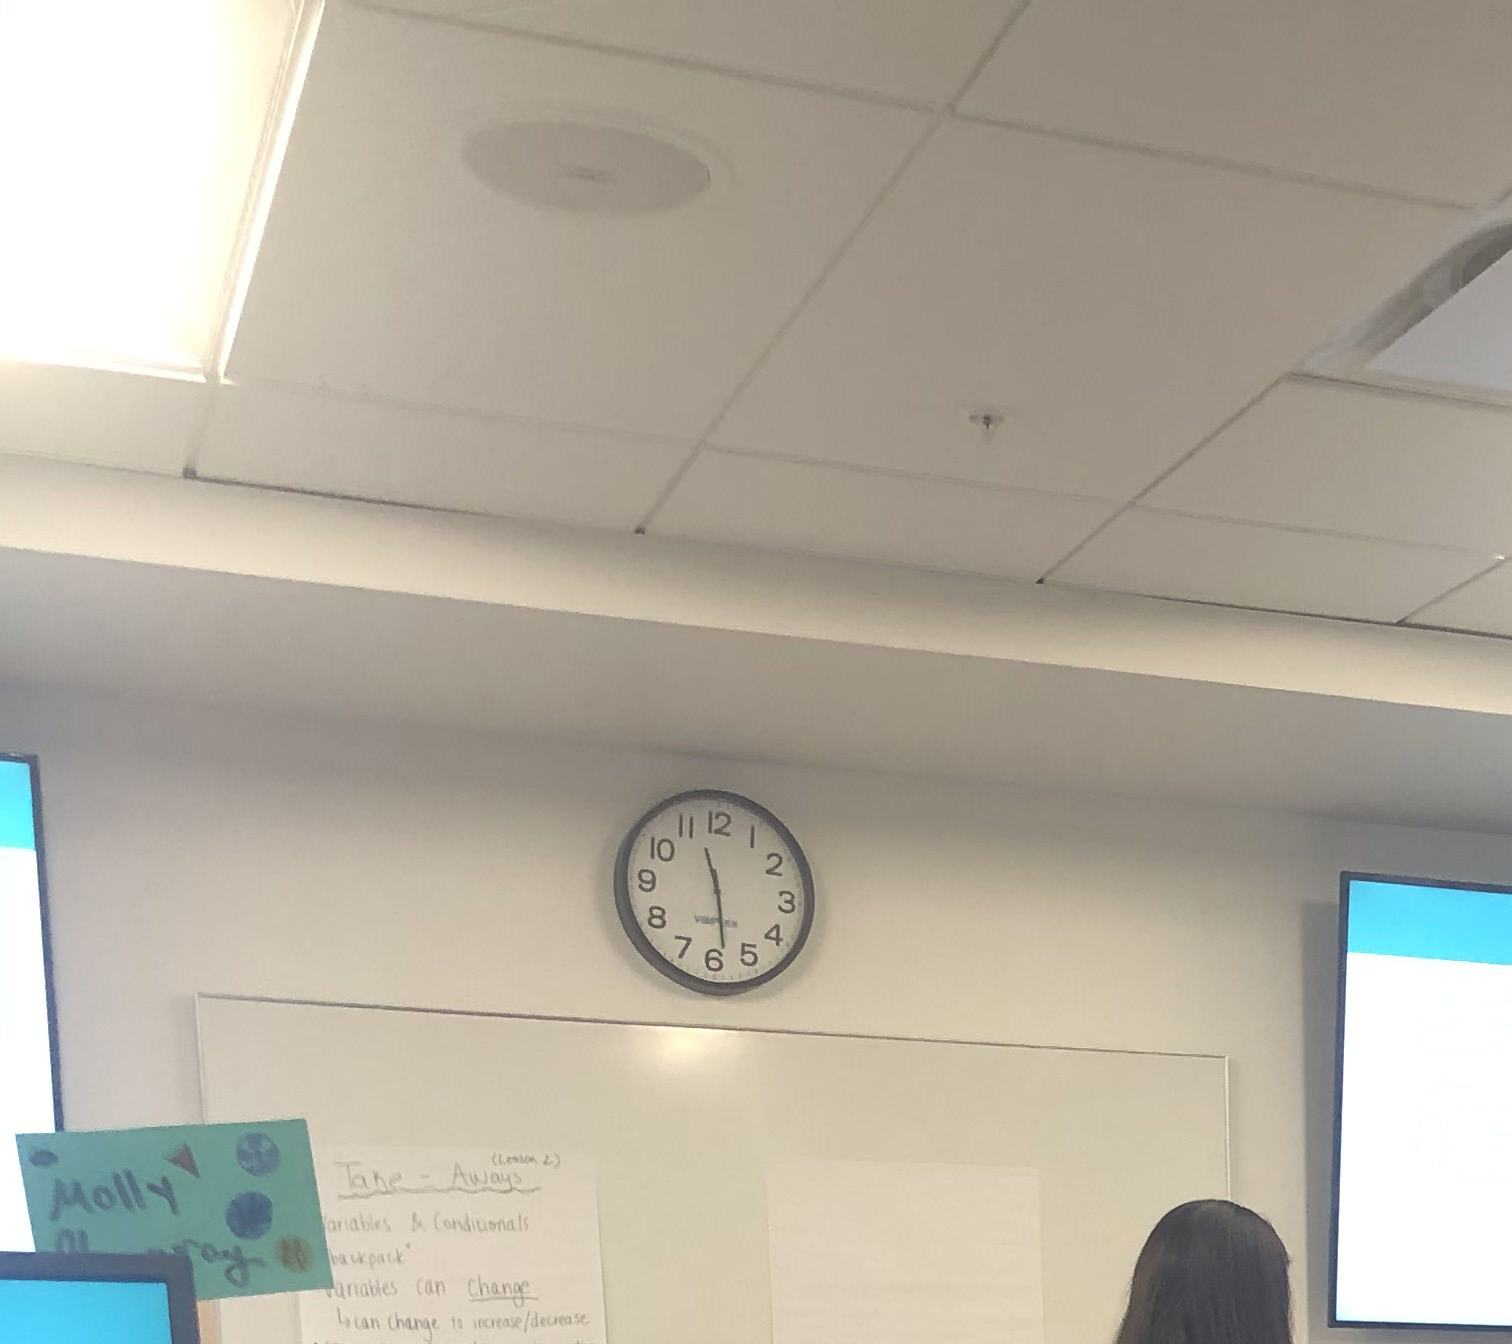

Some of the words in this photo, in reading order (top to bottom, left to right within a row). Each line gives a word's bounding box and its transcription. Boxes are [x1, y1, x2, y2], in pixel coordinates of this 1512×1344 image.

[678, 813, 694, 839] 11
[708, 811, 732, 836] 12
[750, 825, 755, 848] 1
[651, 836, 675, 862] 10
[765, 852, 783, 876] 2
[637, 868, 657, 893] 9
[777, 890, 796, 914] 3
[647, 905, 667, 929] 8
[674, 935, 692, 959] 7
[764, 923, 784, 947] 4
[704, 948, 724, 972] 6
[740, 942, 759, 967] 5
[332, 1161, 403, 1191] Take
[450, 1163, 523, 1190] Aways
[48, 1168, 179, 1221] Molly
[452, 1315, 463, 1330] to
